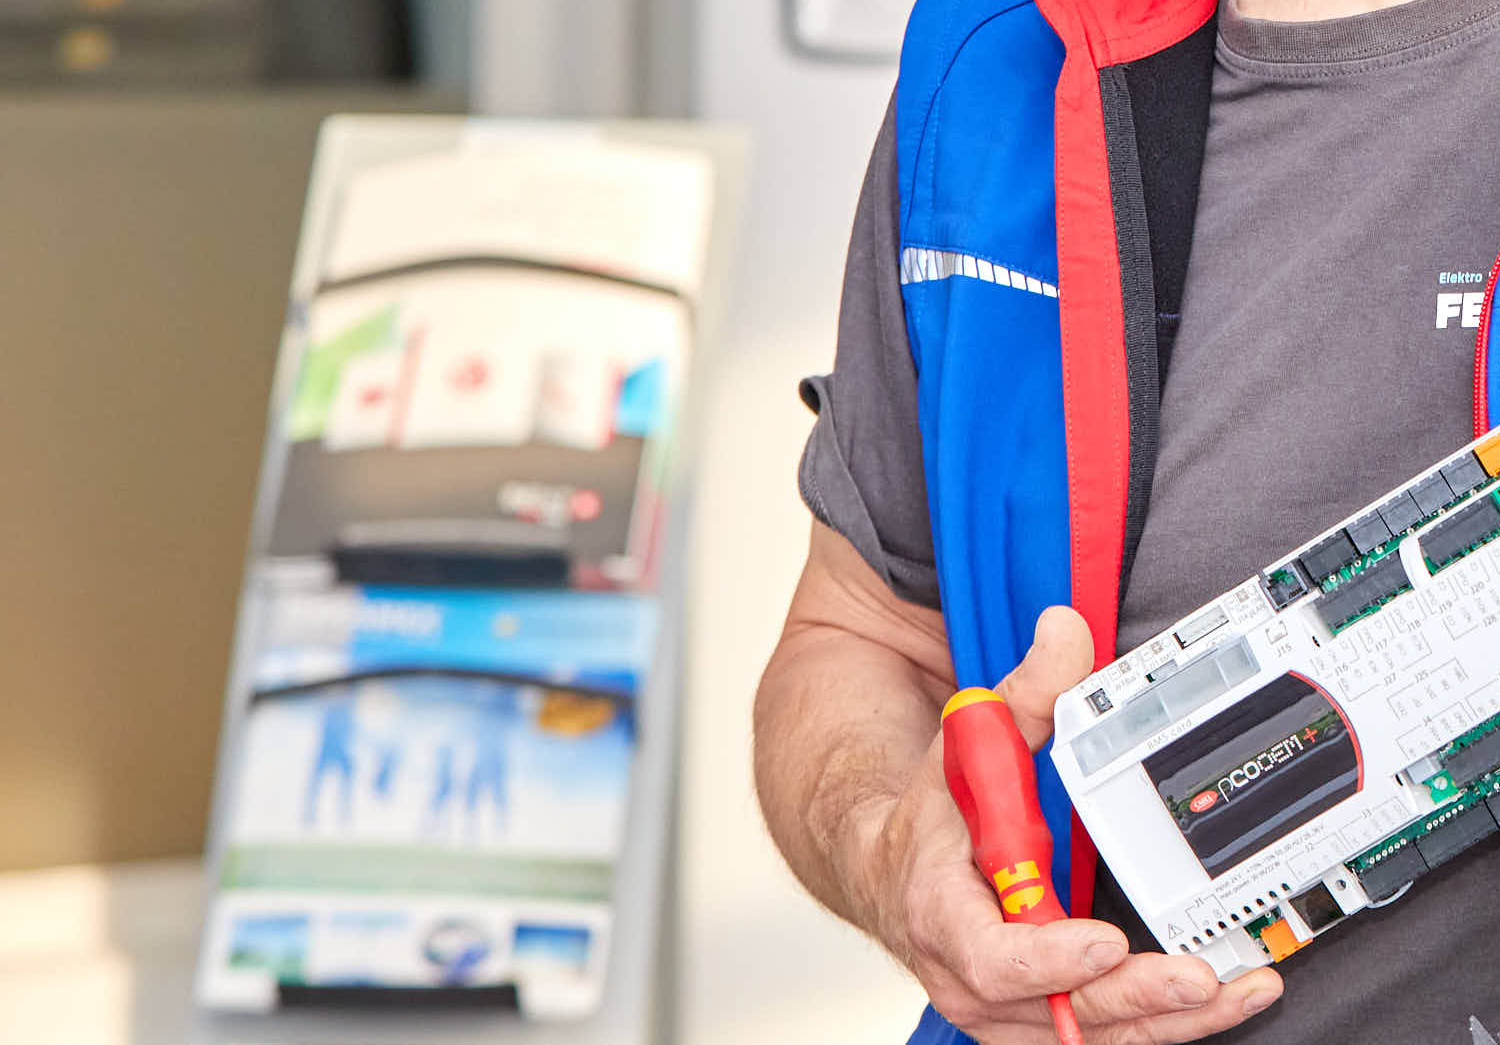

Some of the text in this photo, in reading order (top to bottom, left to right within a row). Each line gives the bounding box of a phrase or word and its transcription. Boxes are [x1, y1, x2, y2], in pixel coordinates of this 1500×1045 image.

[1440, 272, 1482, 284] Elektro
[1436, 293, 1485, 329] FE
[1277, 643, 1292, 658] J15
